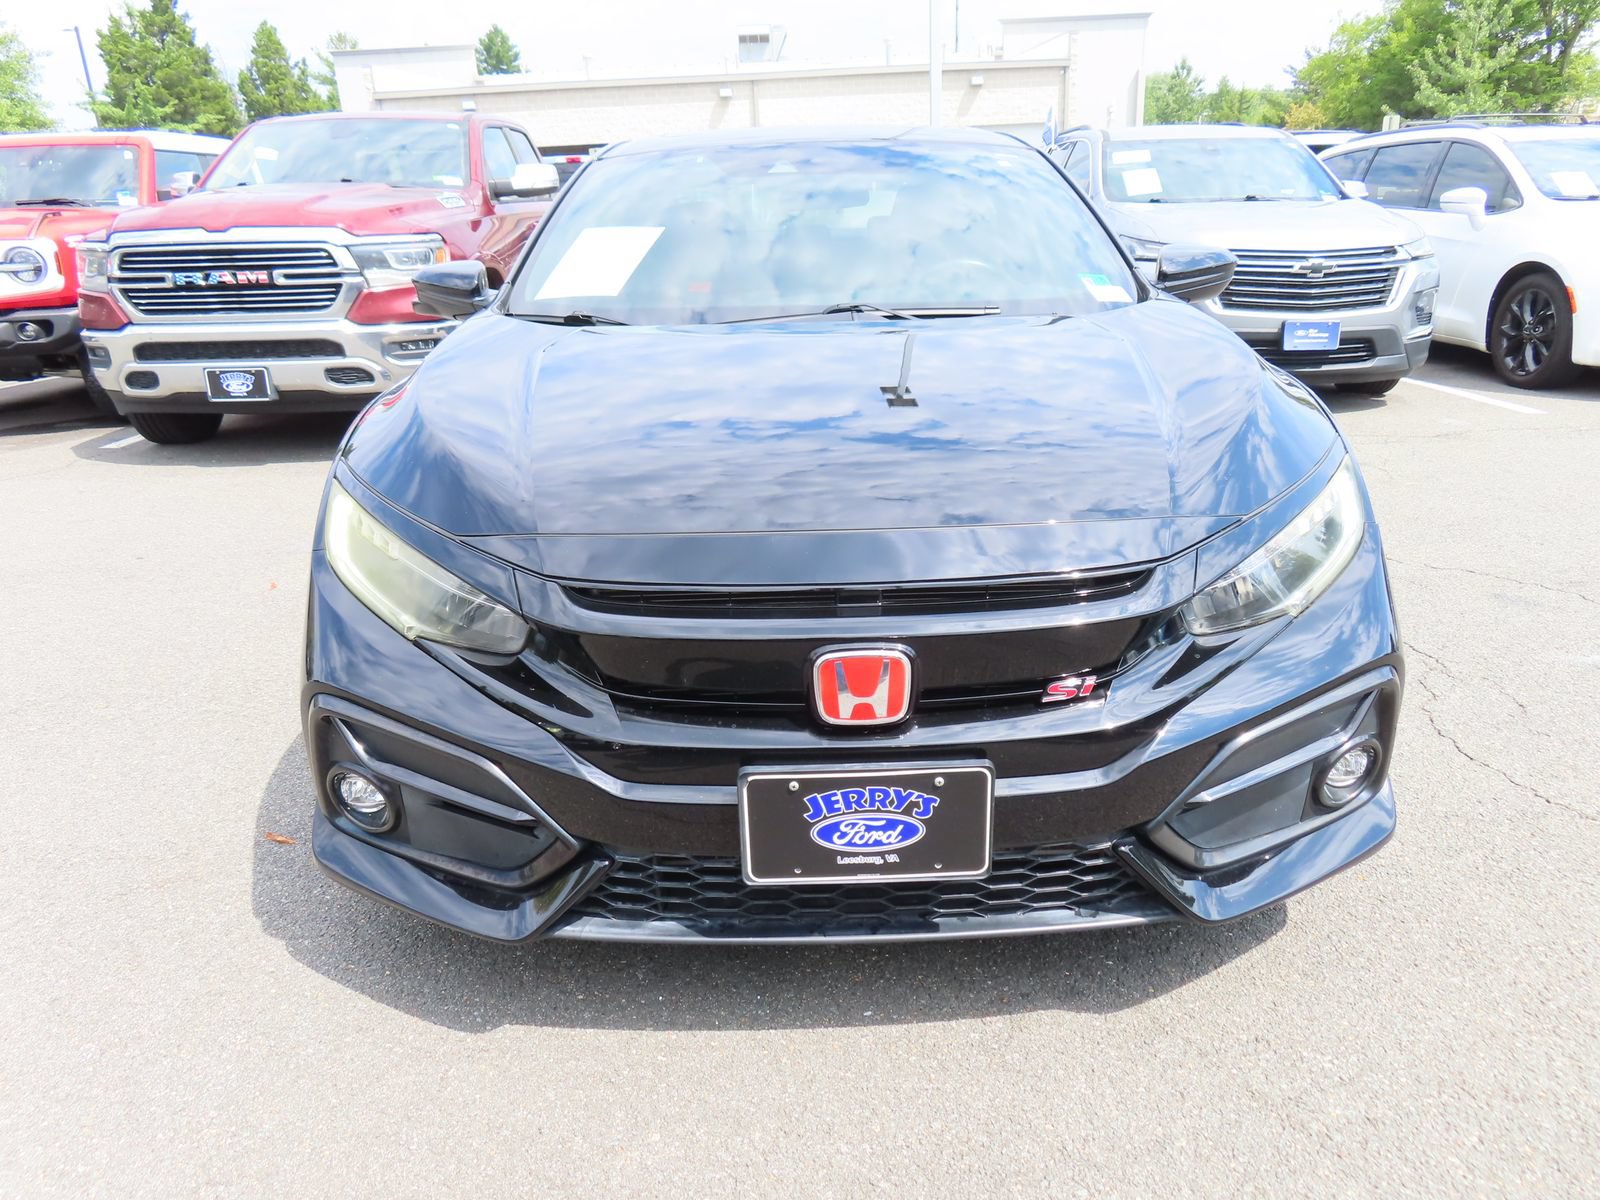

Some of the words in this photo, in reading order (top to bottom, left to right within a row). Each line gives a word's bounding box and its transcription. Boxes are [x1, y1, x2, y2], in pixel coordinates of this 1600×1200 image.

[174, 270, 269, 286] RAM
[803, 786, 940, 822] JERRY'S
[832, 818, 904, 845] Ford
[884, 853, 900, 863] VA
